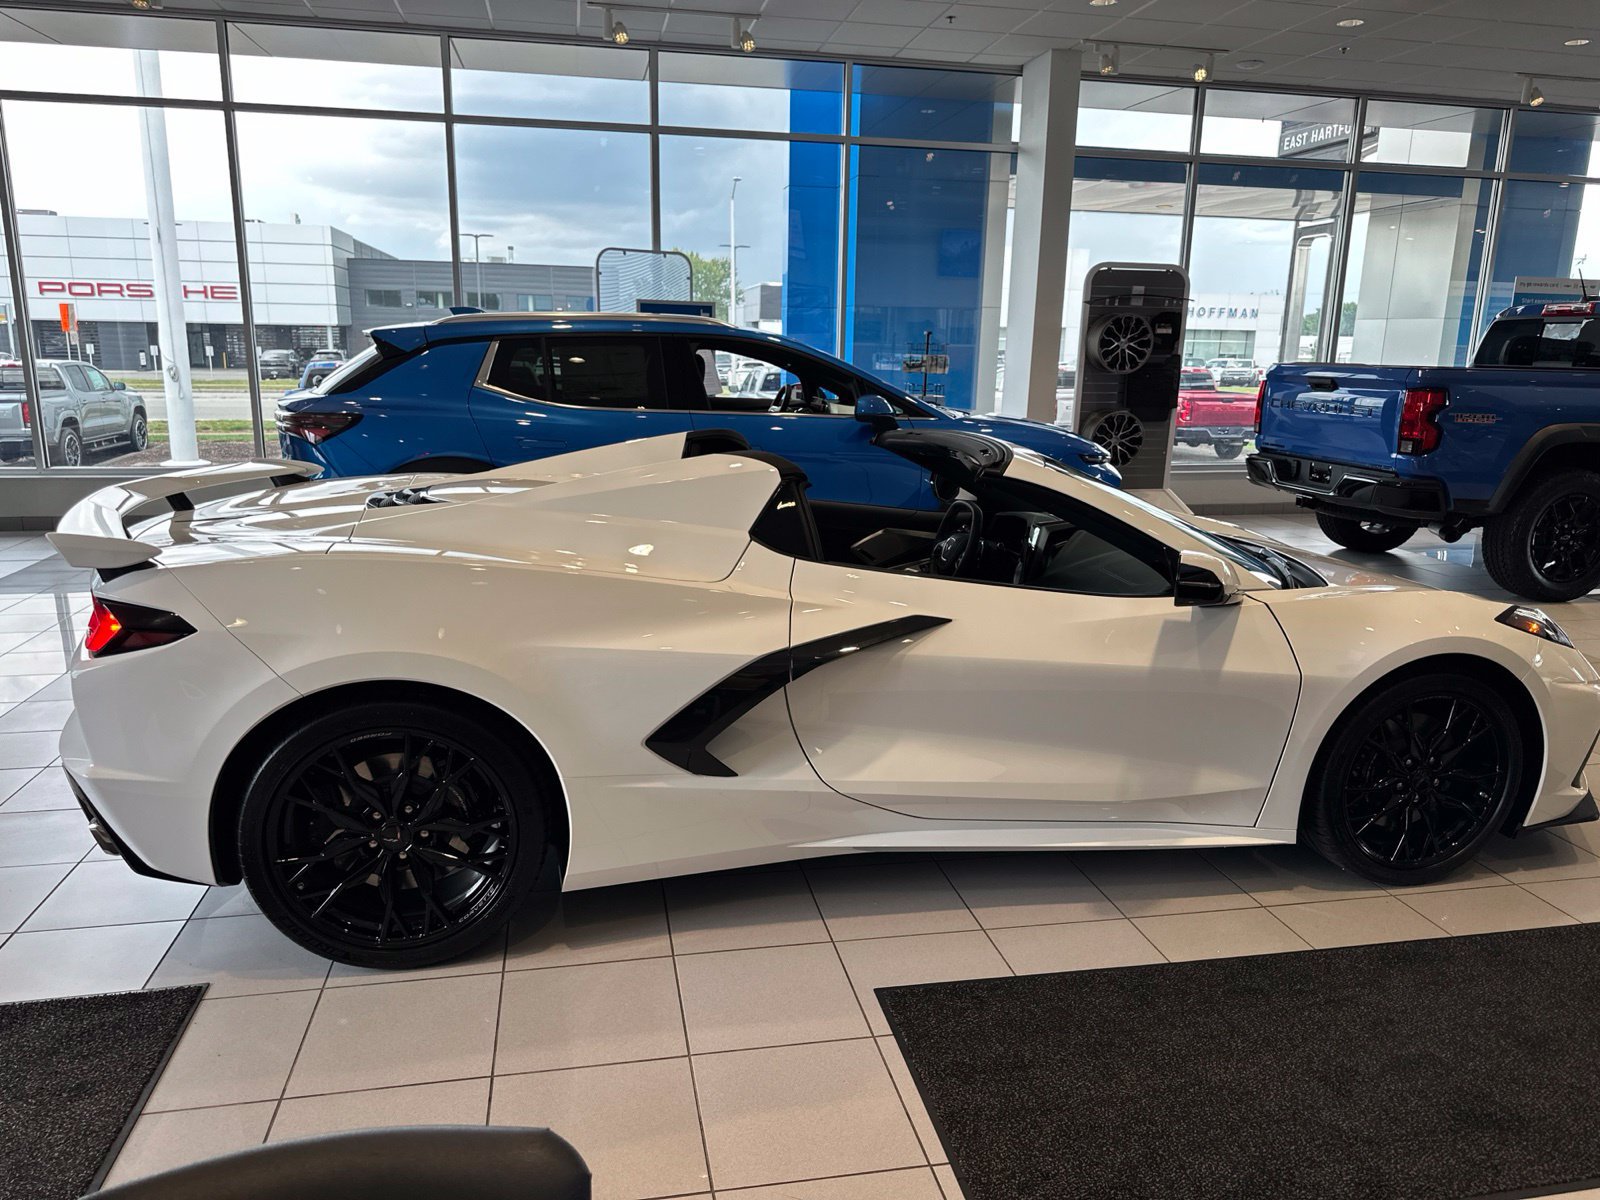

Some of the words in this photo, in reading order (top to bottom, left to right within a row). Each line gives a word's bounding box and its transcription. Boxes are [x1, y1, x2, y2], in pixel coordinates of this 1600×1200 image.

[1283, 131, 1308, 151] EAST
[1310, 124, 1352, 144] HARTFO
[37, 281, 239, 300] PORSHE
[1187, 306, 1259, 319] HOFFMAN
[1270, 398, 1376, 418] CHEVROLET
